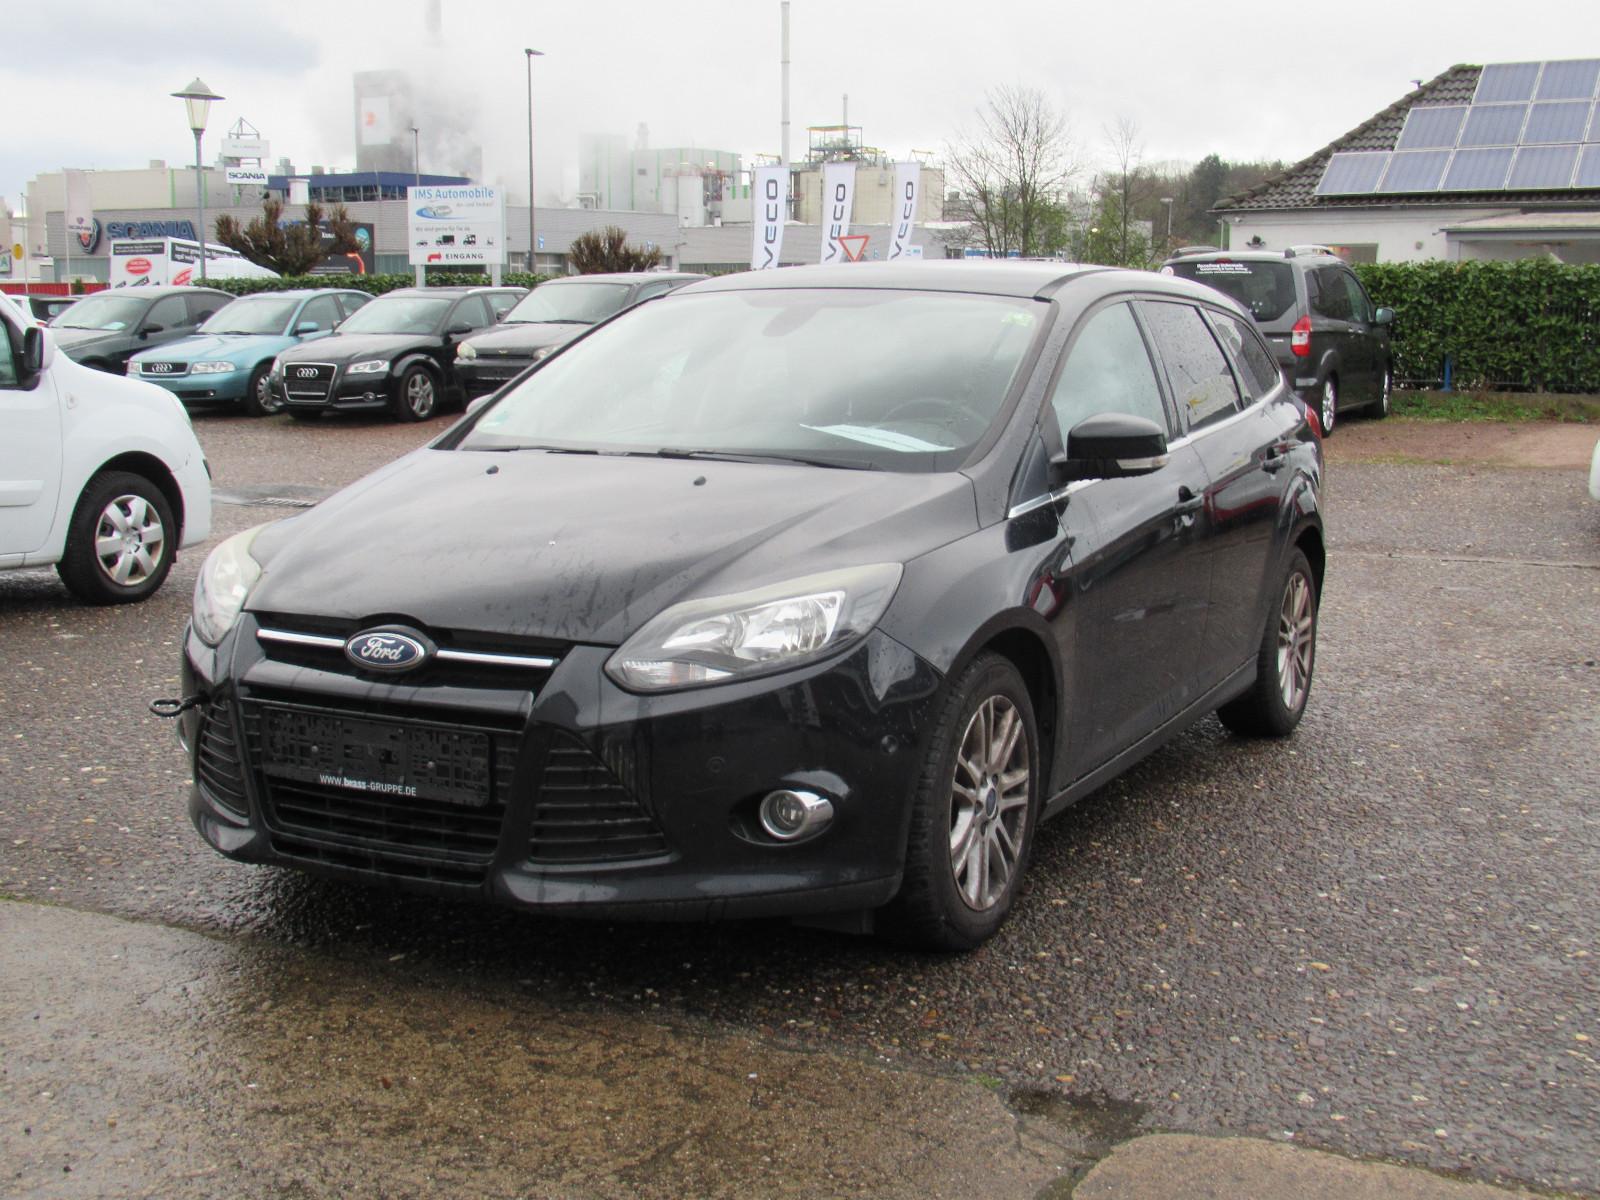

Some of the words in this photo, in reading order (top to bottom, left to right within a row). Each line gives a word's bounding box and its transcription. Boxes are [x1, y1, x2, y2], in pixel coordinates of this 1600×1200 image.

[228, 171, 266, 180] SCANIA
[414, 188, 433, 199] IMS
[435, 187, 494, 199] Automobile
[106, 220, 197, 241] SCANIA
[763, 179, 778, 269] VECO
[825, 183, 846, 261] VECO
[890, 181, 914, 259] VECO
[361, 636, 405, 661] Ford
